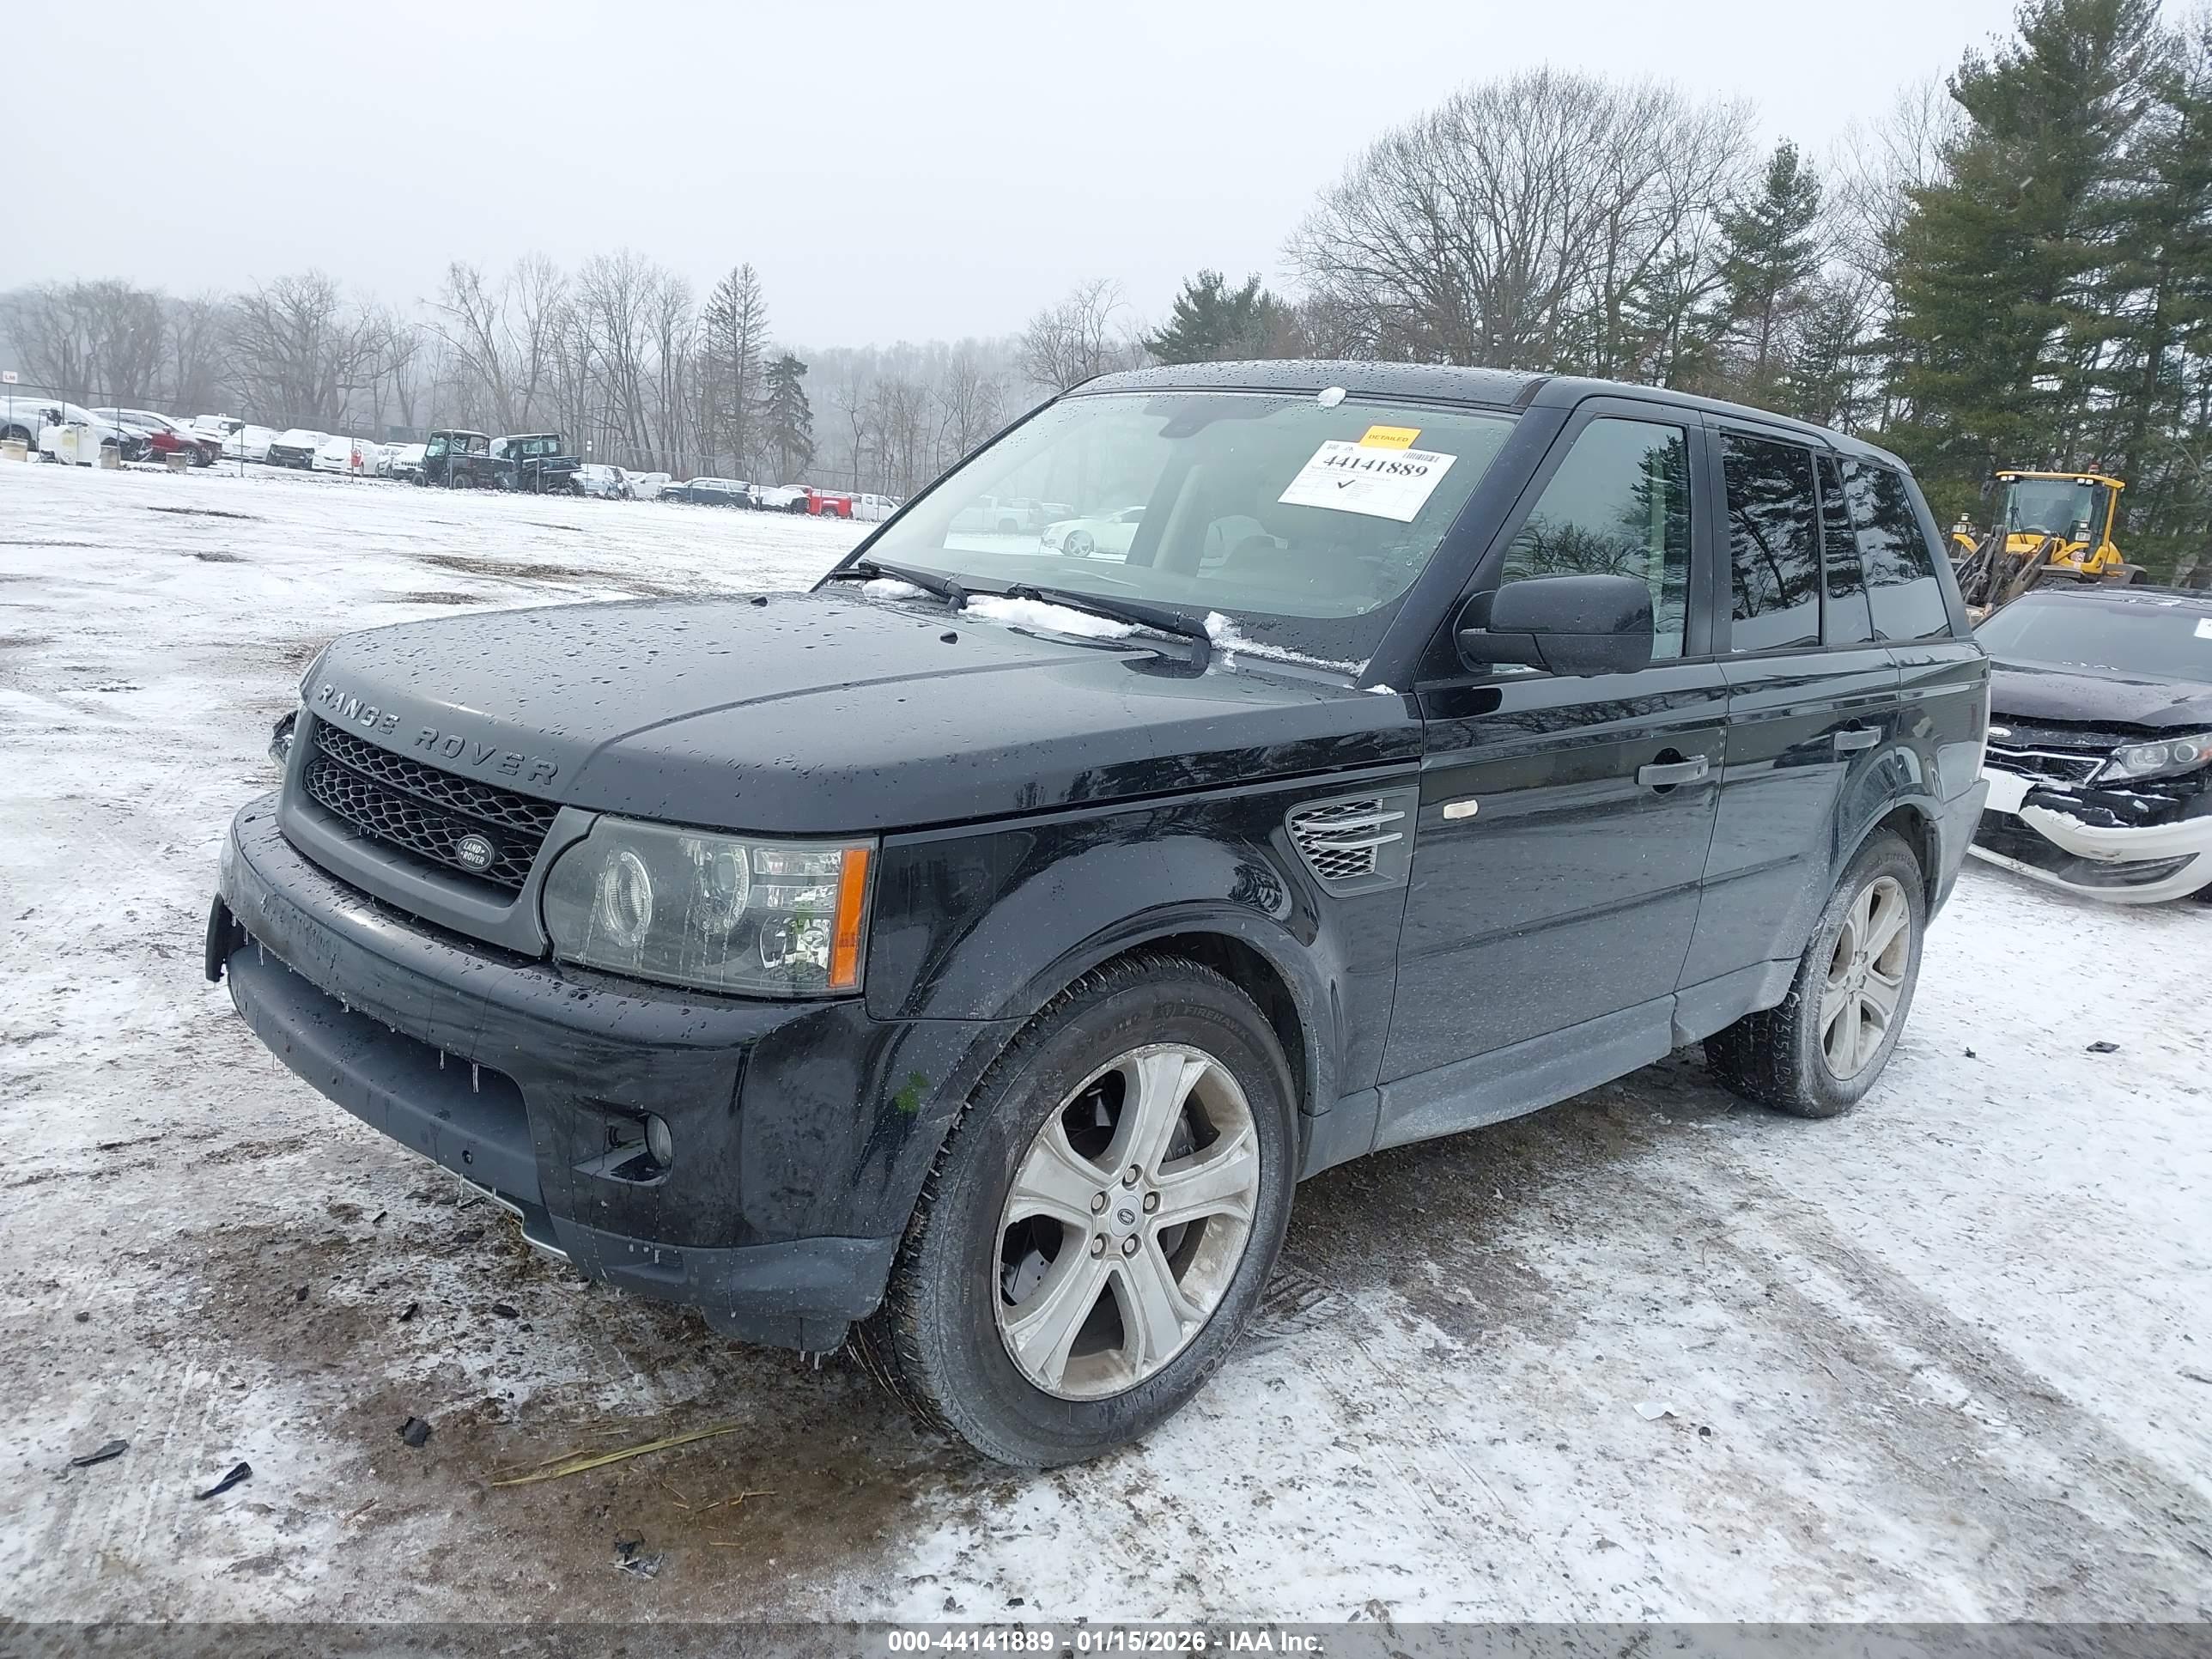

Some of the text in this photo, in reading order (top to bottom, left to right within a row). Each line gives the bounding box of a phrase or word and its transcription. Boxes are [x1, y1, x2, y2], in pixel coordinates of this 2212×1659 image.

[1323, 455, 1429, 478] 44141889
[317, 684, 559, 786] RANGE ROVER
[463, 841, 482, 854] LAND
[462, 851, 485, 866] ROVER
